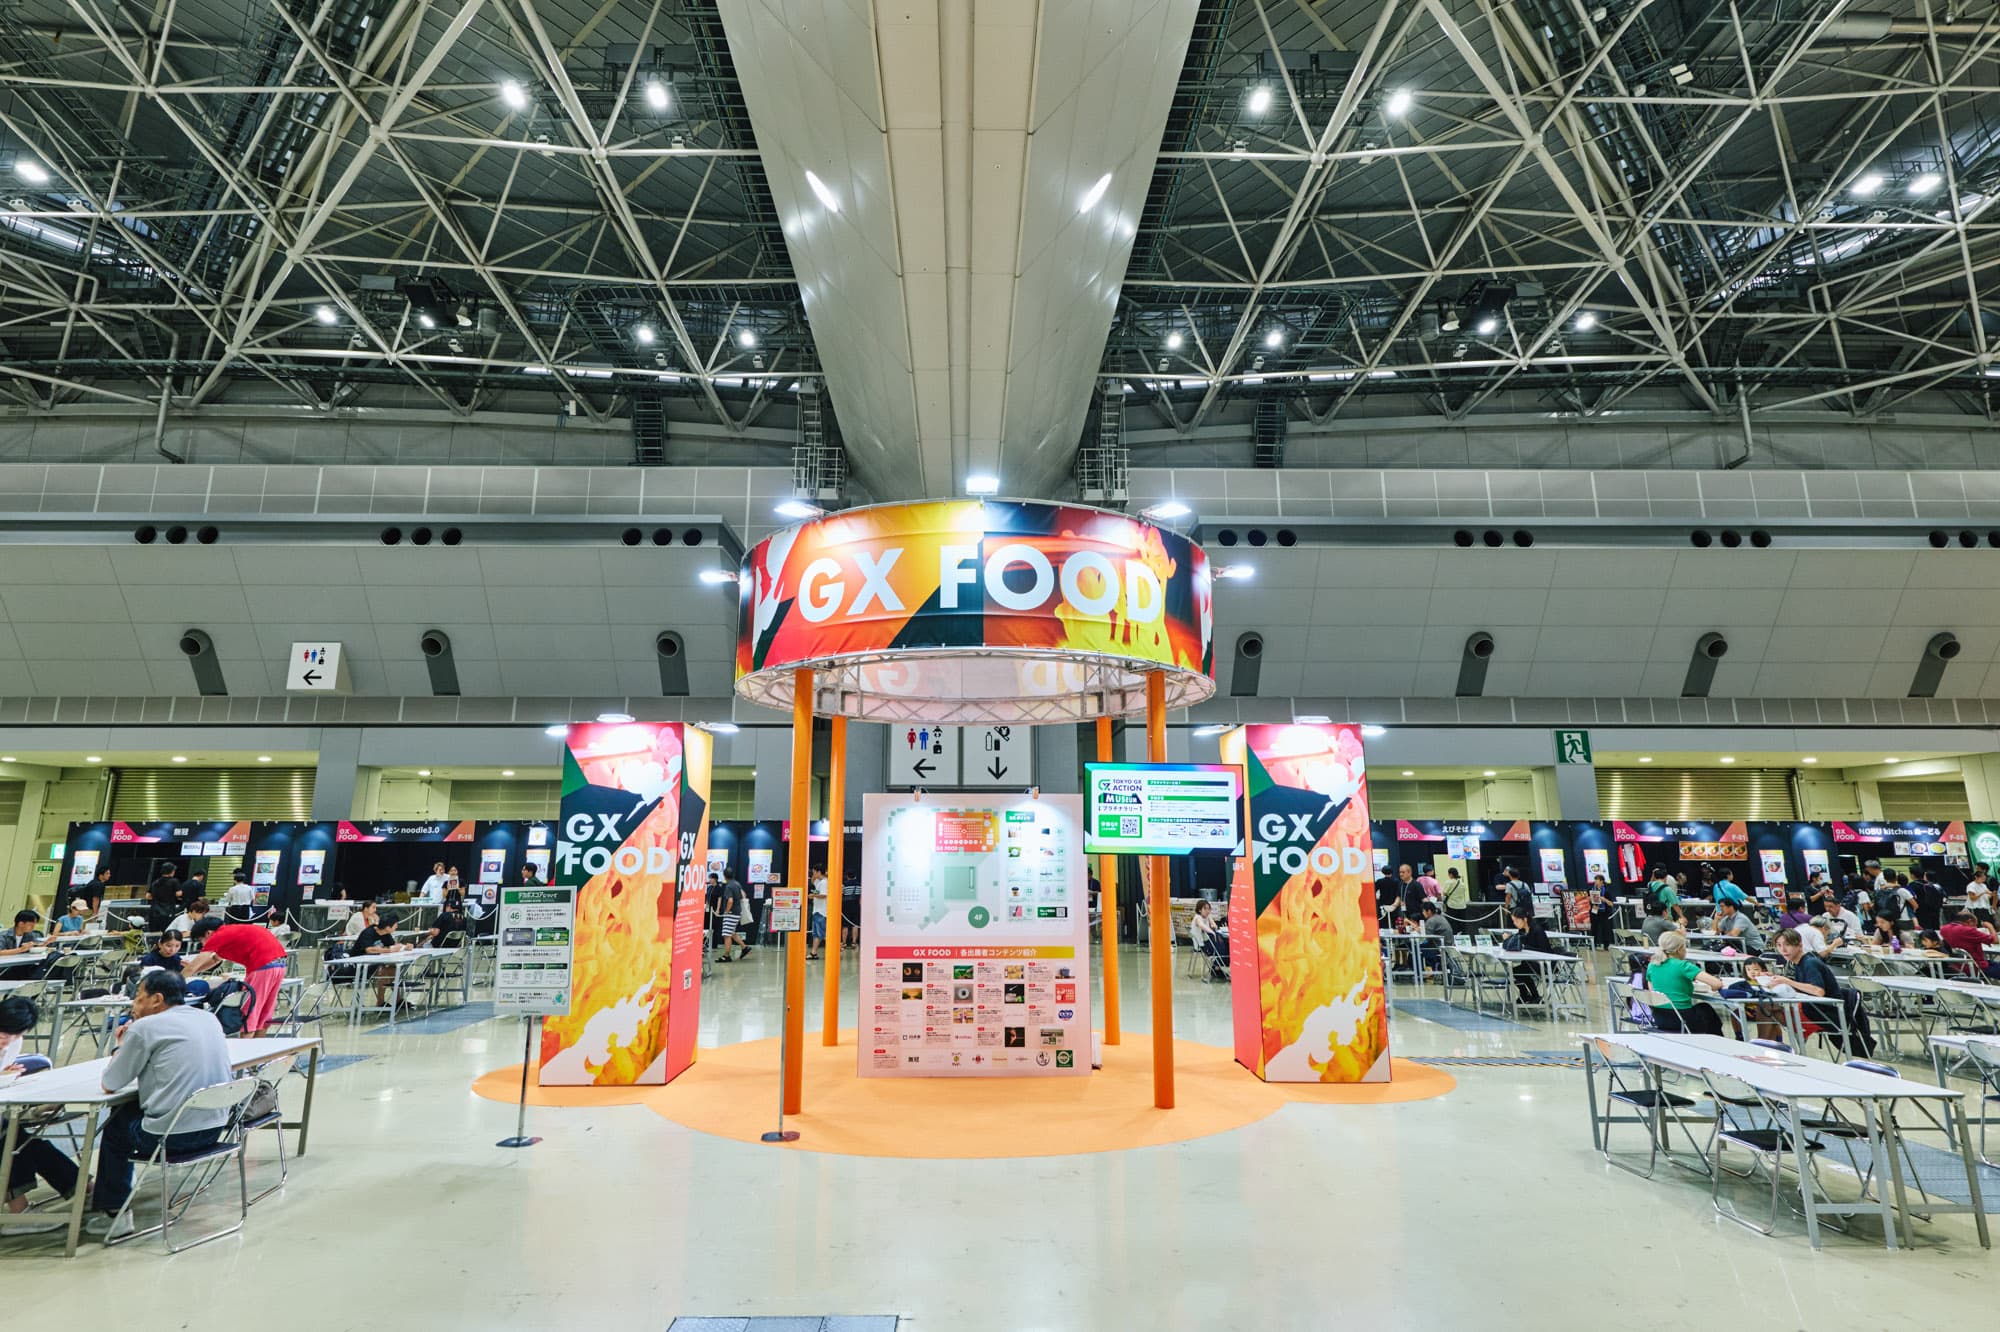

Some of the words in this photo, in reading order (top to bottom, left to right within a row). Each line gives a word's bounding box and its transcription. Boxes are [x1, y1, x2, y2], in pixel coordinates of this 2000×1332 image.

[799, 548, 906, 622] GX
[940, 544, 1161, 623] FOOD
[1106, 793, 1138, 803] MUSEUM
[401, 826, 440, 834] noodle3.0
[566, 813, 623, 842] GX
[1259, 813, 1316, 842] GX
[1442, 825, 1469, 833] えびそば
[680, 832, 696, 860] GX
[564, 846, 671, 876] FOOD
[1261, 846, 1367, 876] FOOD
[679, 864, 705, 892] FOOD
[510, 912, 520, 920] 46
